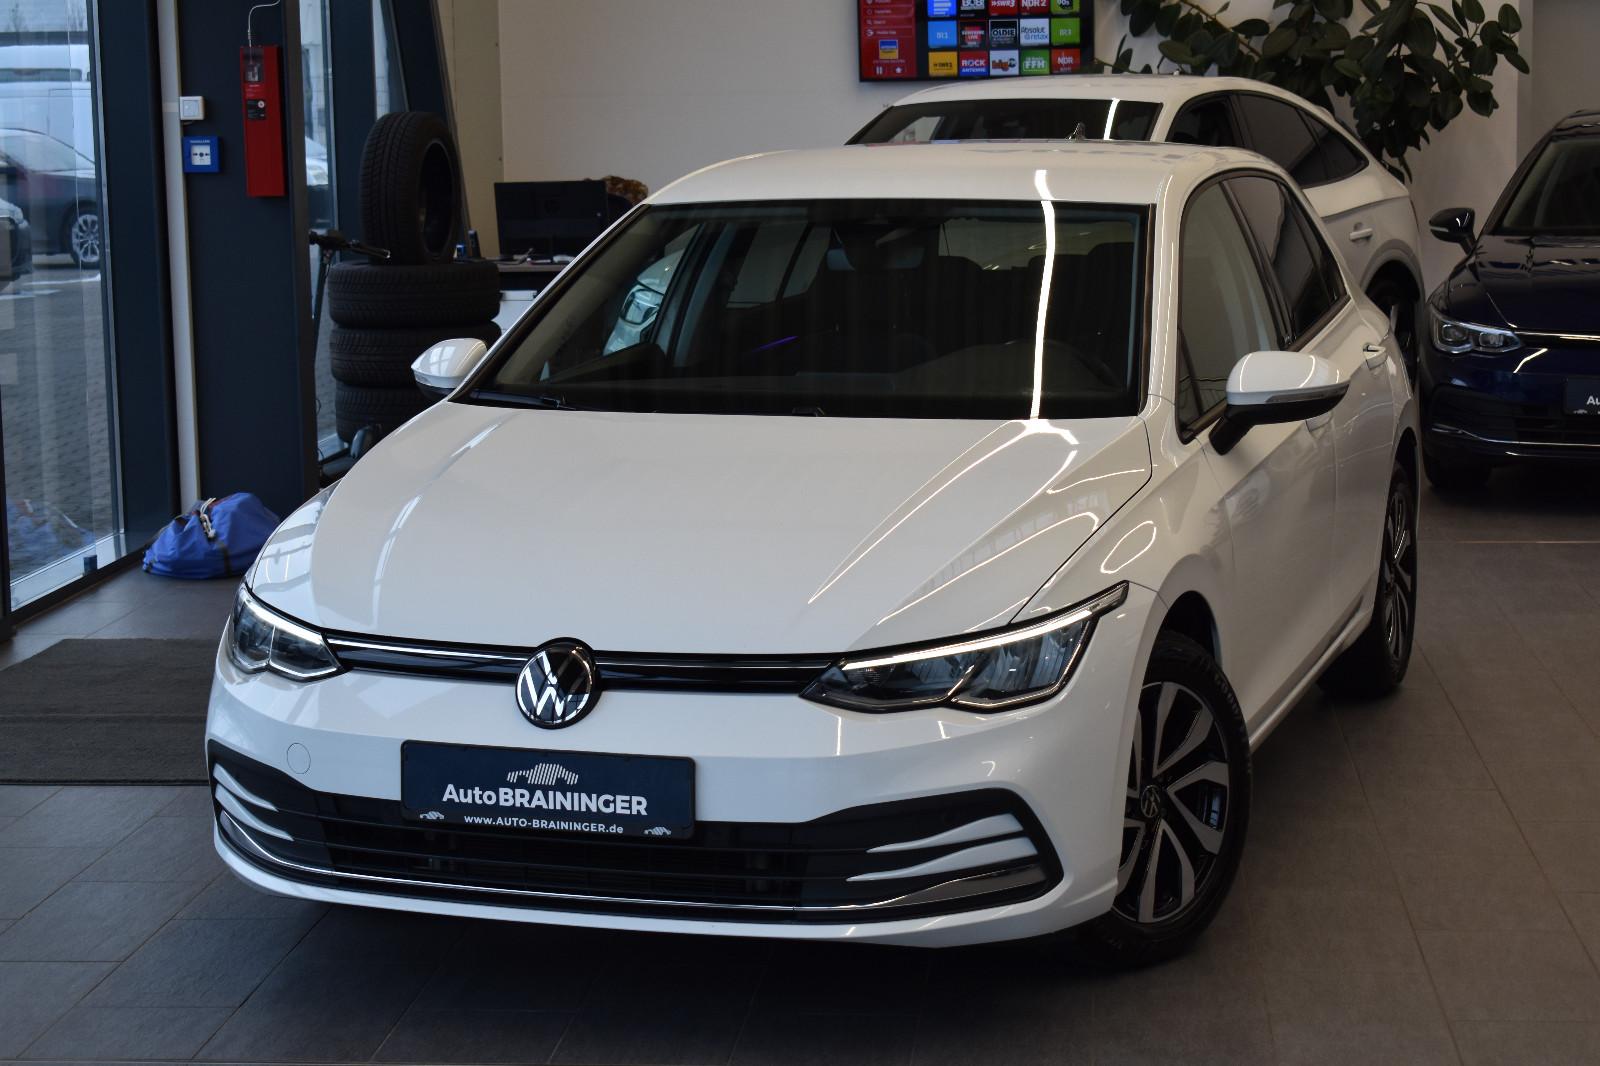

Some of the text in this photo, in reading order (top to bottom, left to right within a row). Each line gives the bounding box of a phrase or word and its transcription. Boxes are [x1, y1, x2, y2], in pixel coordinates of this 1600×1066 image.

[1021, 0, 1040, 8] NDR
[992, 28, 1016, 37] OLDIE
[961, 59, 985, 67] ROCK
[1057, 56, 1073, 64] NDR
[463, 814, 624, 834] www.AUTO-BRAININGER.de
